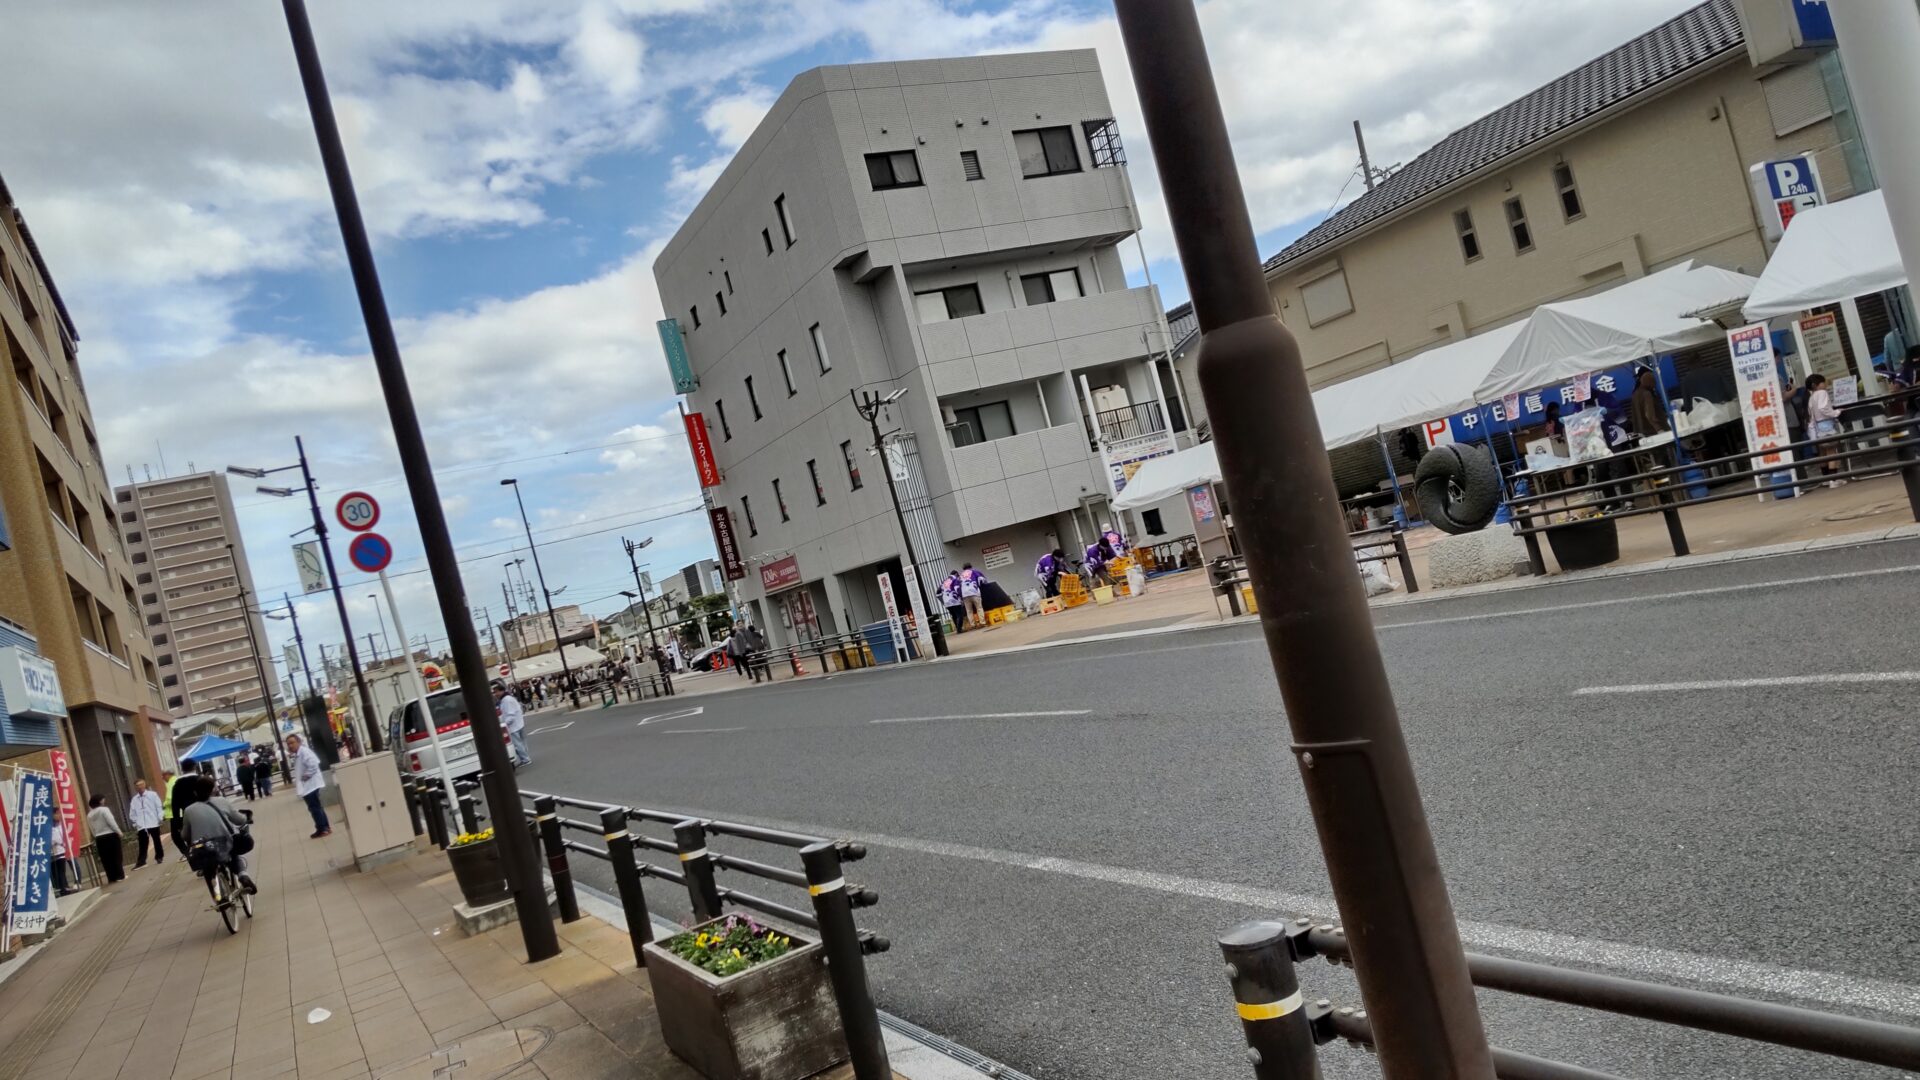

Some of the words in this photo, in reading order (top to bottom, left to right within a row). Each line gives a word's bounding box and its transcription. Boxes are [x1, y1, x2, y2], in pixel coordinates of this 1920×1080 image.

[1774, 162, 1799, 197] P
[1790, 183, 1808, 195] 24h
[1462, 368, 1640, 431] 中日信用金
[1425, 417, 1447, 446] P
[1750, 388, 1782, 464] 似顔絵
[345, 501, 371, 521] 30
[715, 513, 738, 570] 北名古屋接骨院
[29, 784, 51, 904] 喪中はがき
[14, 915, 46, 930] 受付中
